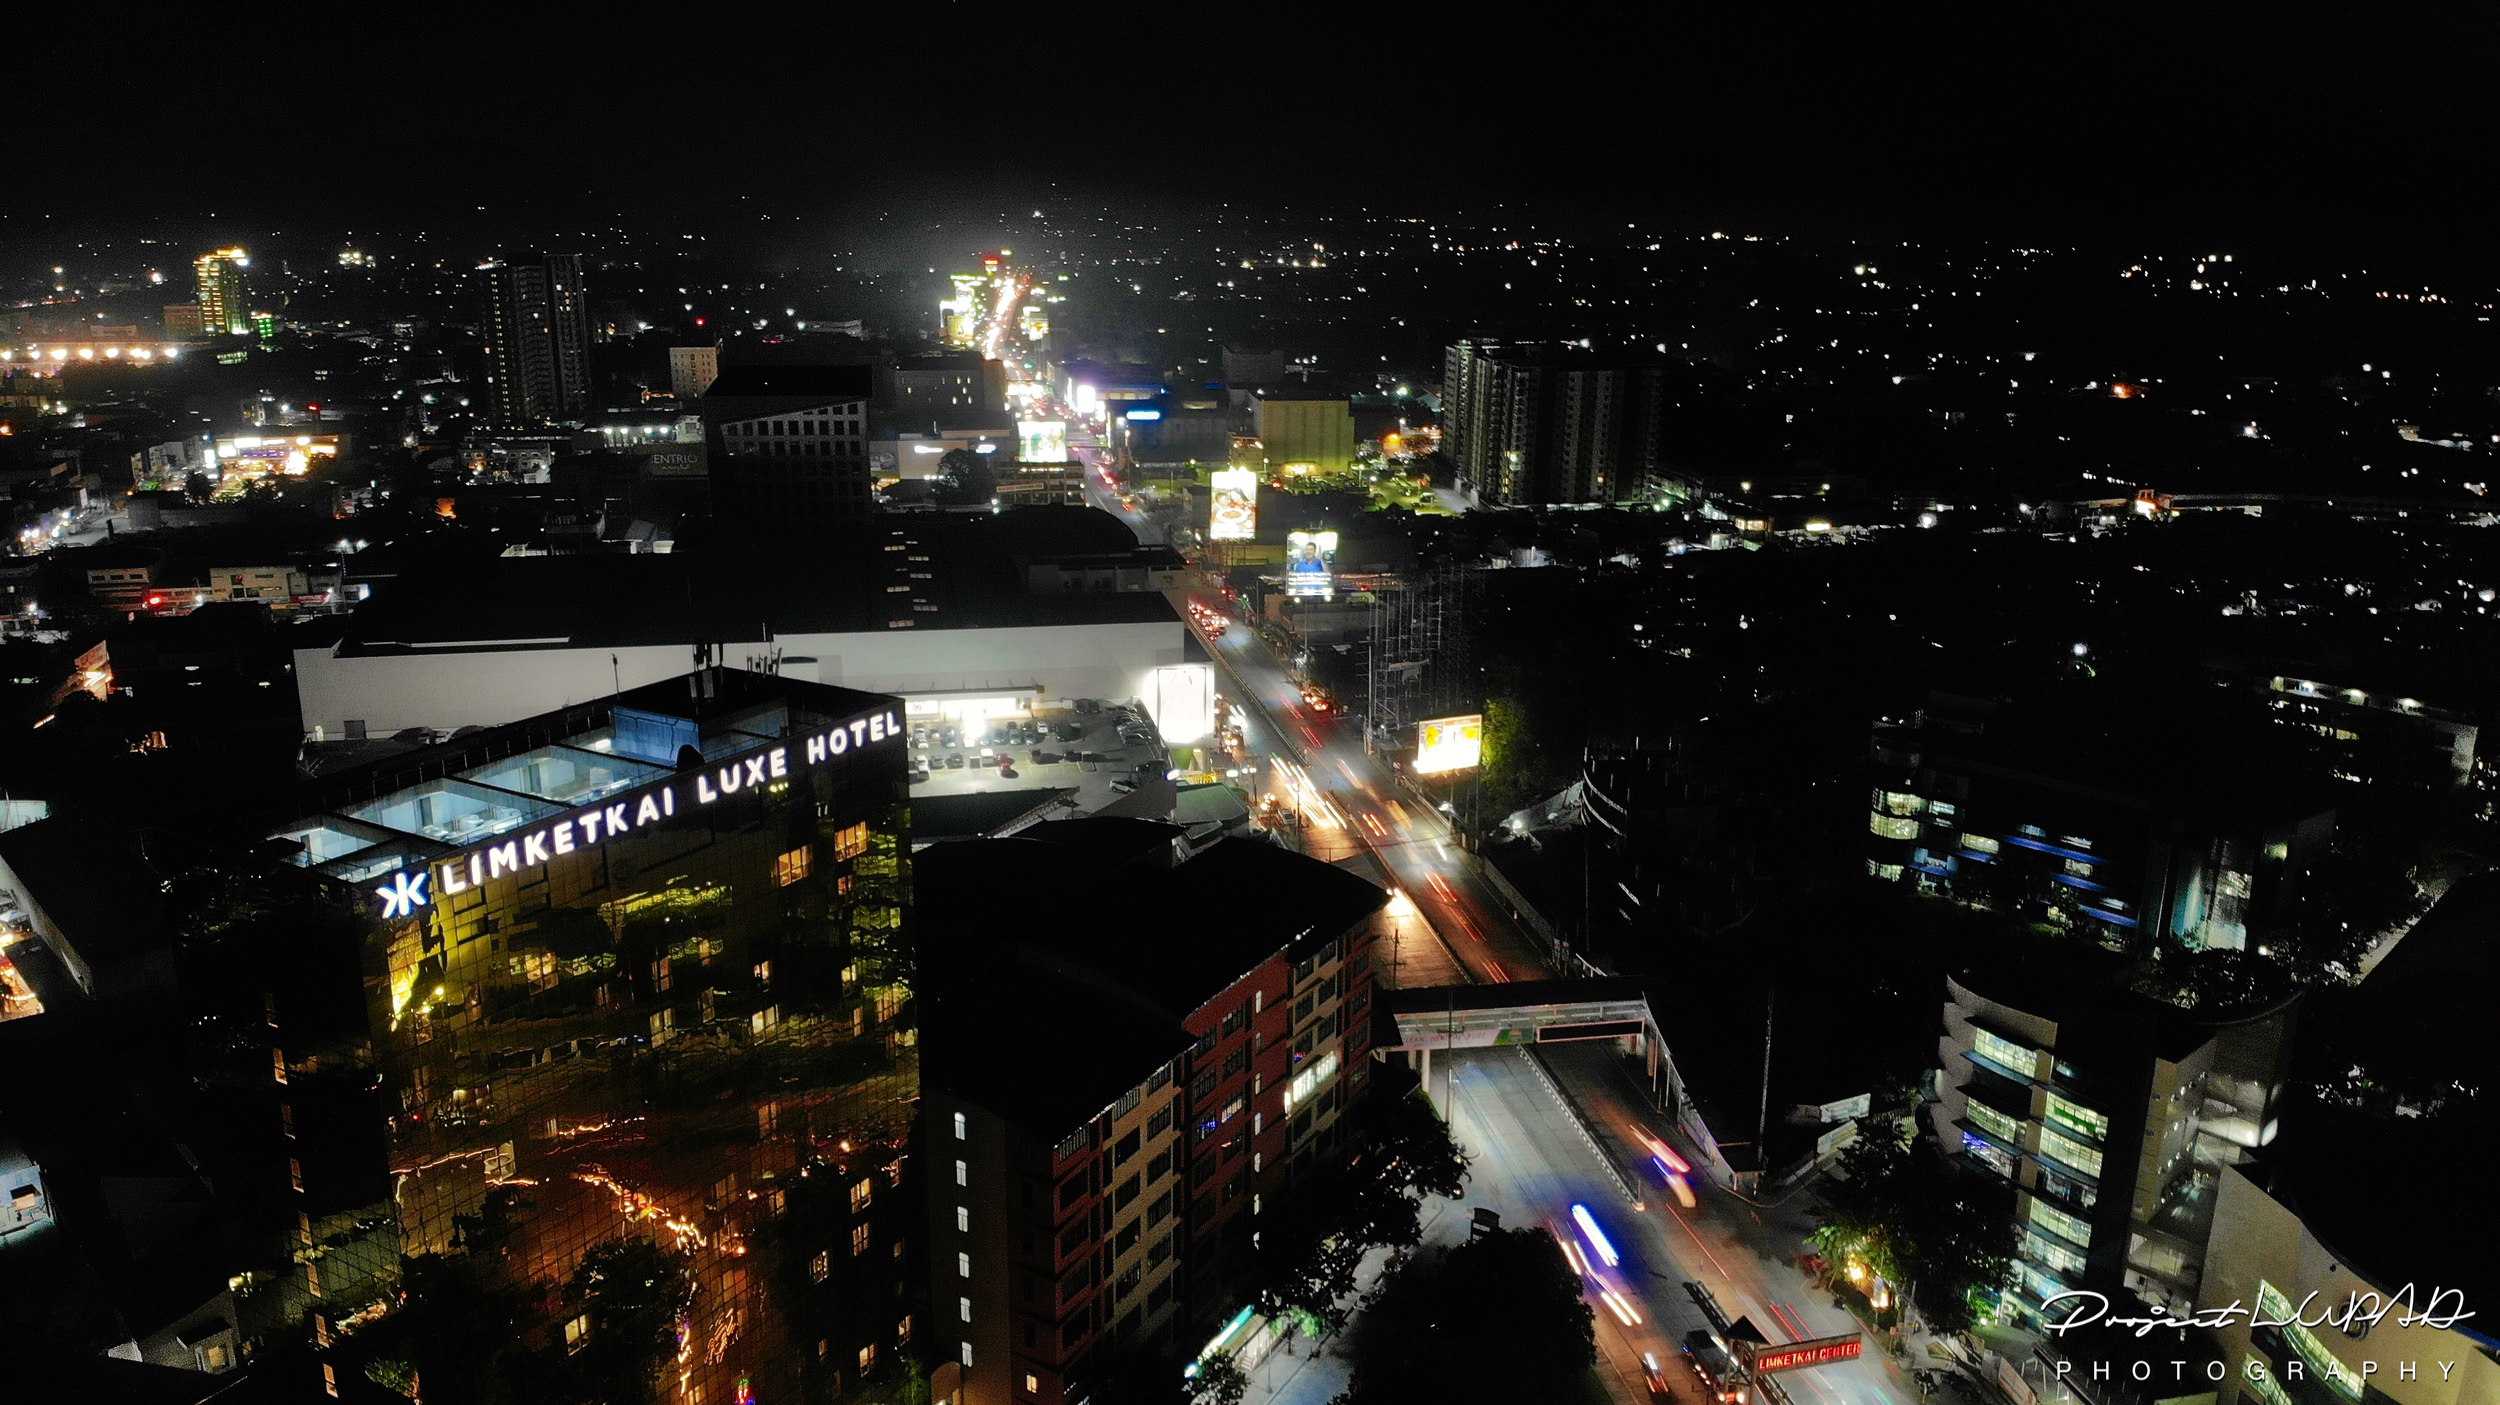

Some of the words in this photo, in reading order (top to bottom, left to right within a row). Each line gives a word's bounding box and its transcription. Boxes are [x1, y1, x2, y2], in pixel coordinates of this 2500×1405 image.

[442, 786, 674, 895] LIMKETKAI
[697, 747, 788, 804] LUXE
[806, 711, 901, 765] HOTEL
[1759, 1349, 1817, 1370] LIMKETKAI
[1819, 1342, 1861, 1361] CENTER
